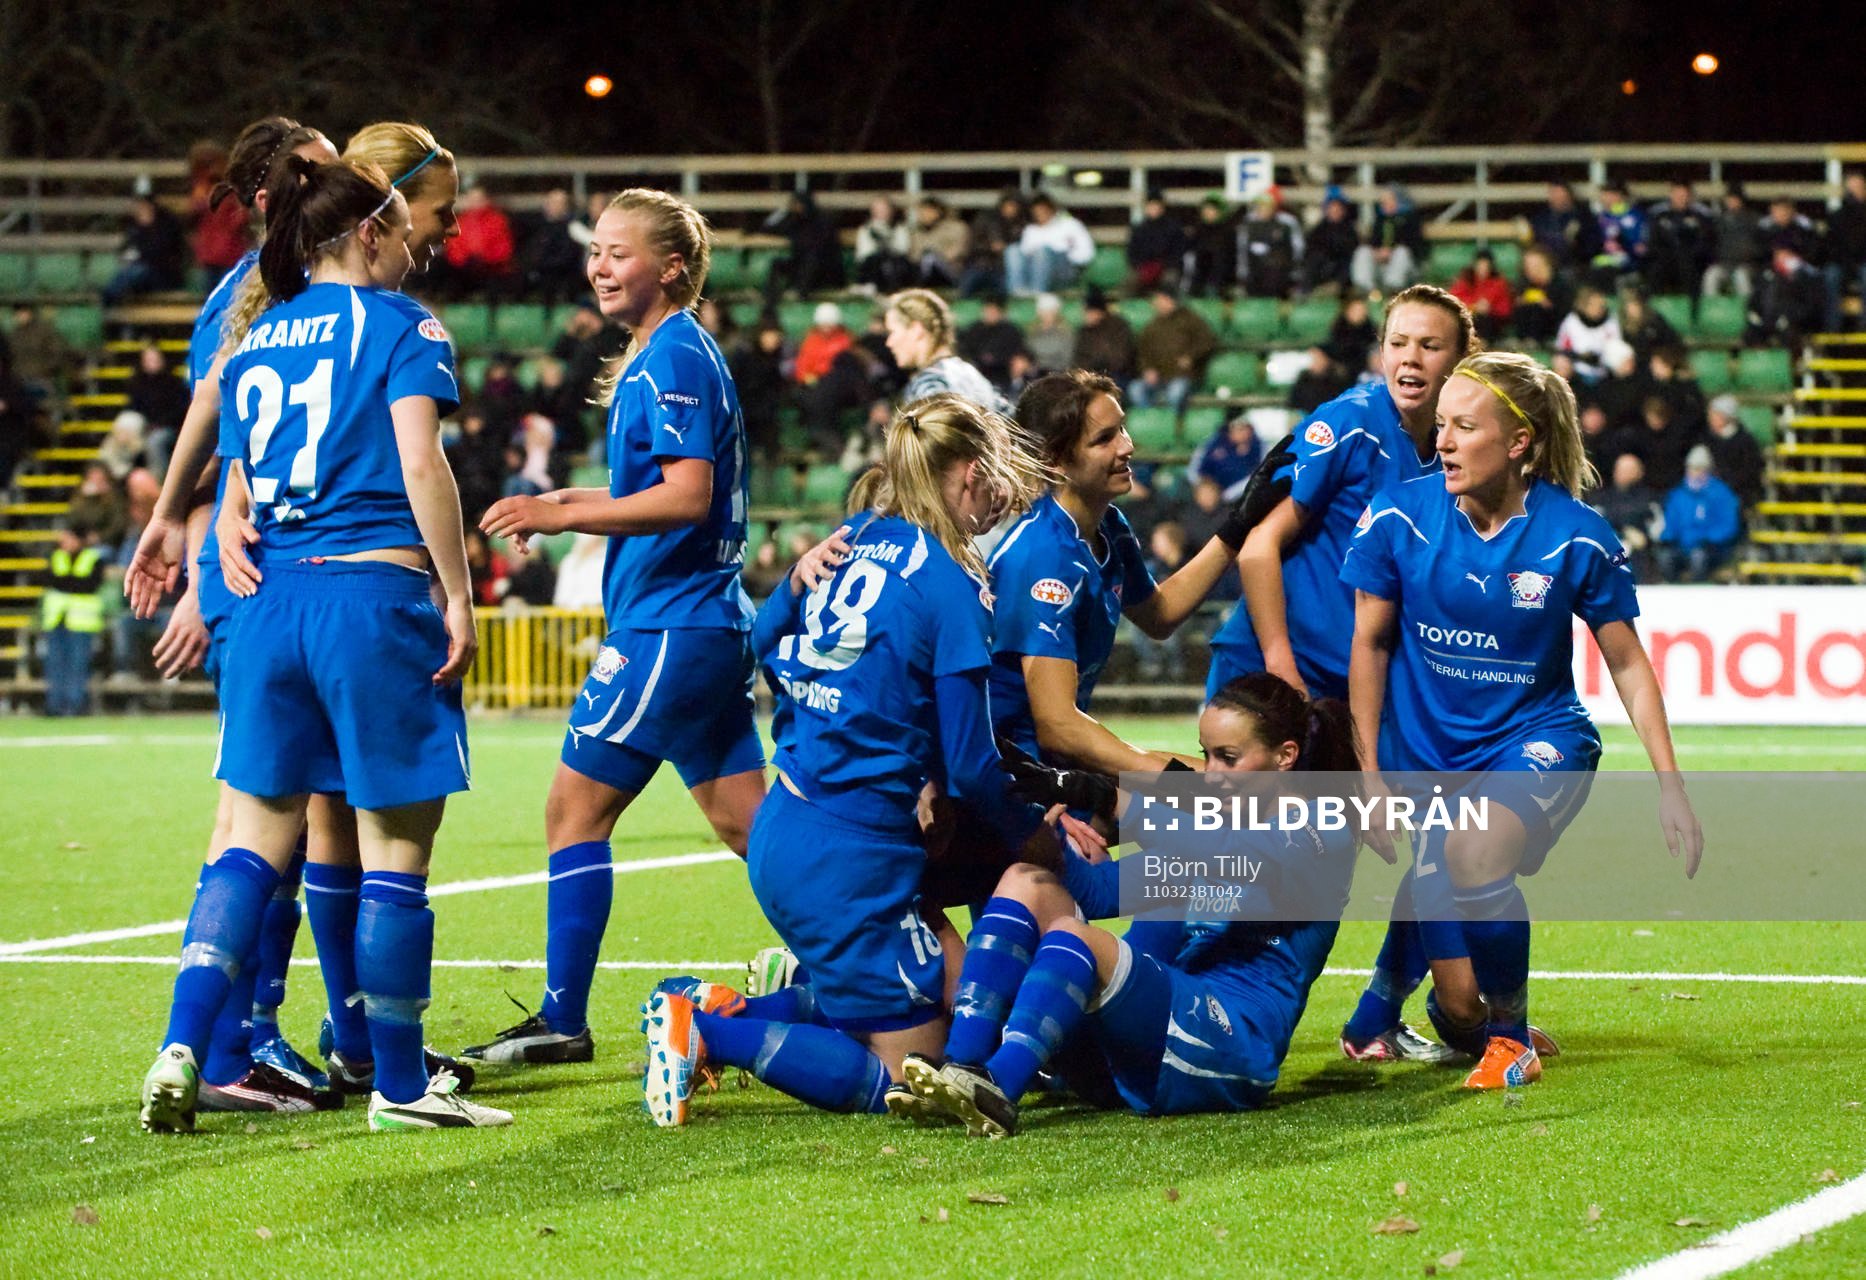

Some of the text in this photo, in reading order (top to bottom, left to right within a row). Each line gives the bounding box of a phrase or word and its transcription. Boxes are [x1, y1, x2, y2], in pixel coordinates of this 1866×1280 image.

[1239, 158, 1262, 192] F
[664, 392, 700, 406] RESPECT
[236, 357, 334, 502] 21
[838, 539, 904, 564] STRÖM
[776, 557, 887, 671] 18
[1416, 621, 1500, 651] TOYOTA
[1424, 655, 1536, 685] TERIAL HANDLING
[1187, 896, 1243, 914] TOYOTA
